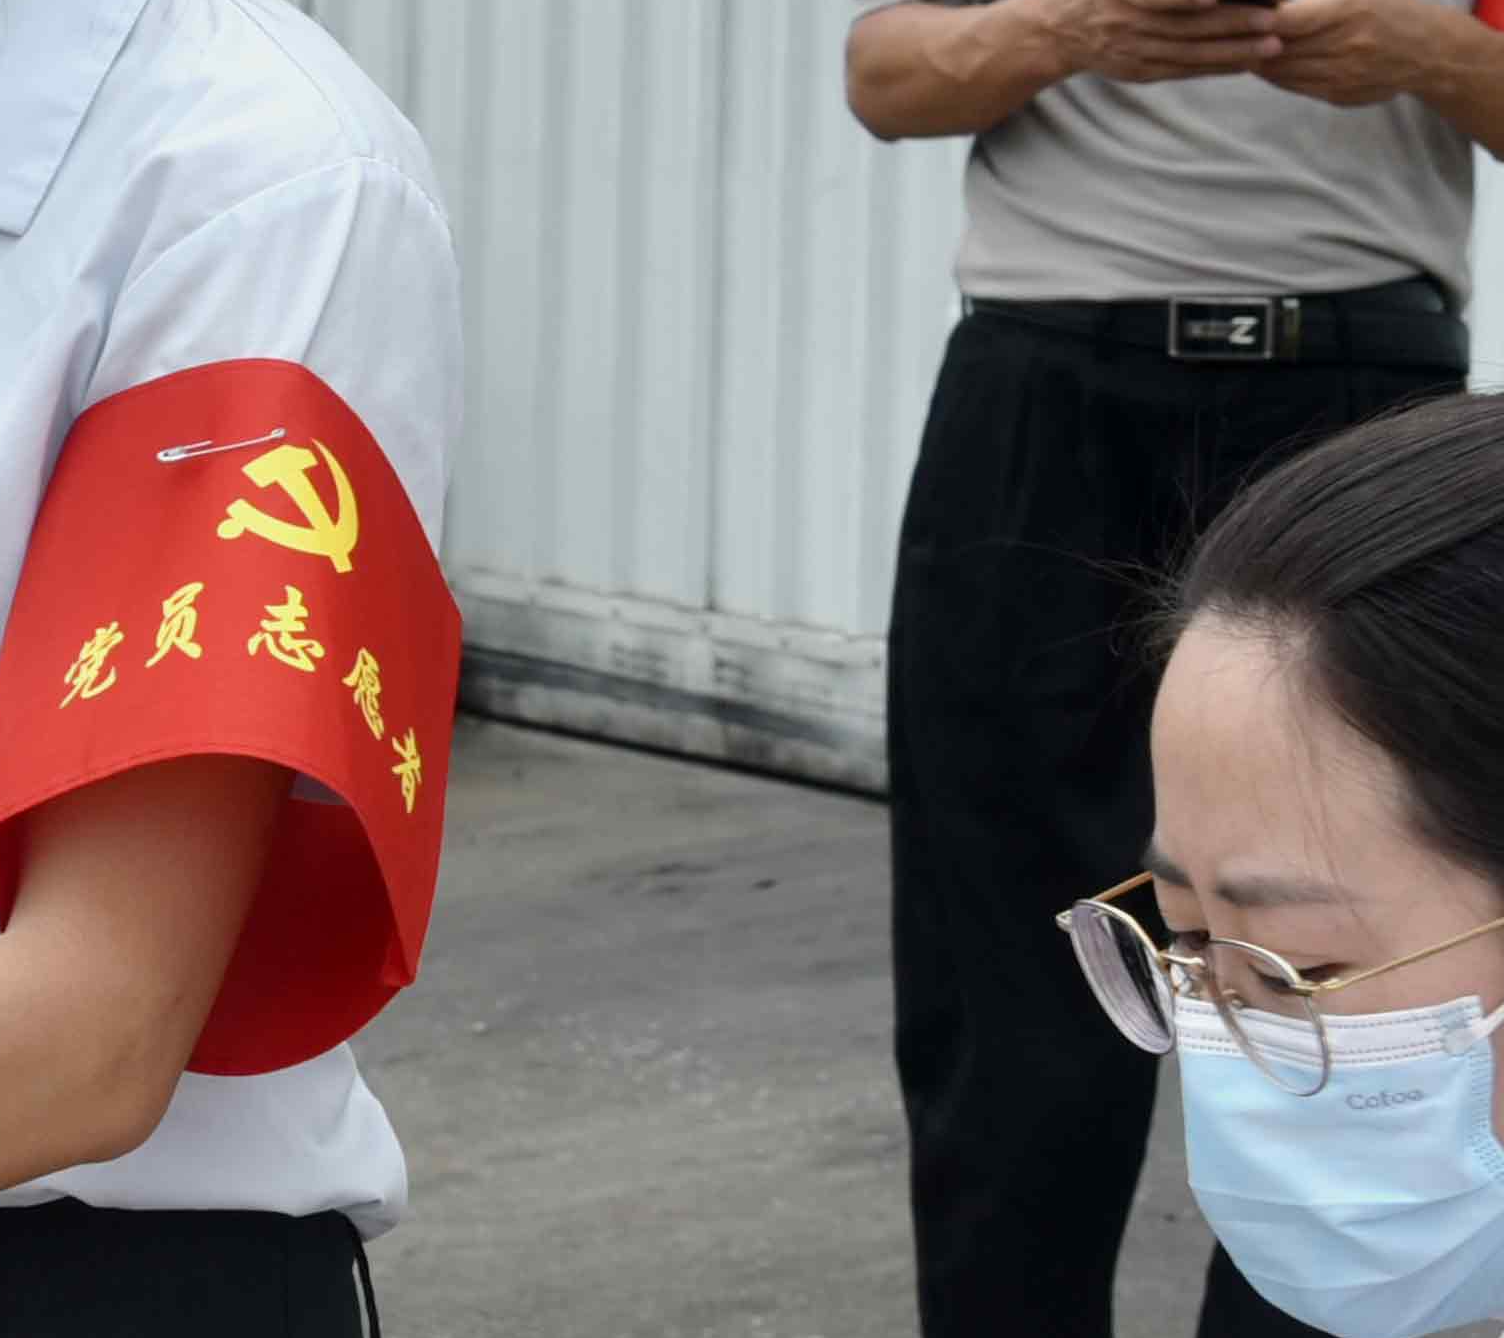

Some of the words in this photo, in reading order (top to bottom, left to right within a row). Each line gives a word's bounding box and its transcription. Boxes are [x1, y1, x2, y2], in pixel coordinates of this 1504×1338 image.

[58, 581, 422, 814] 党员志愿者
